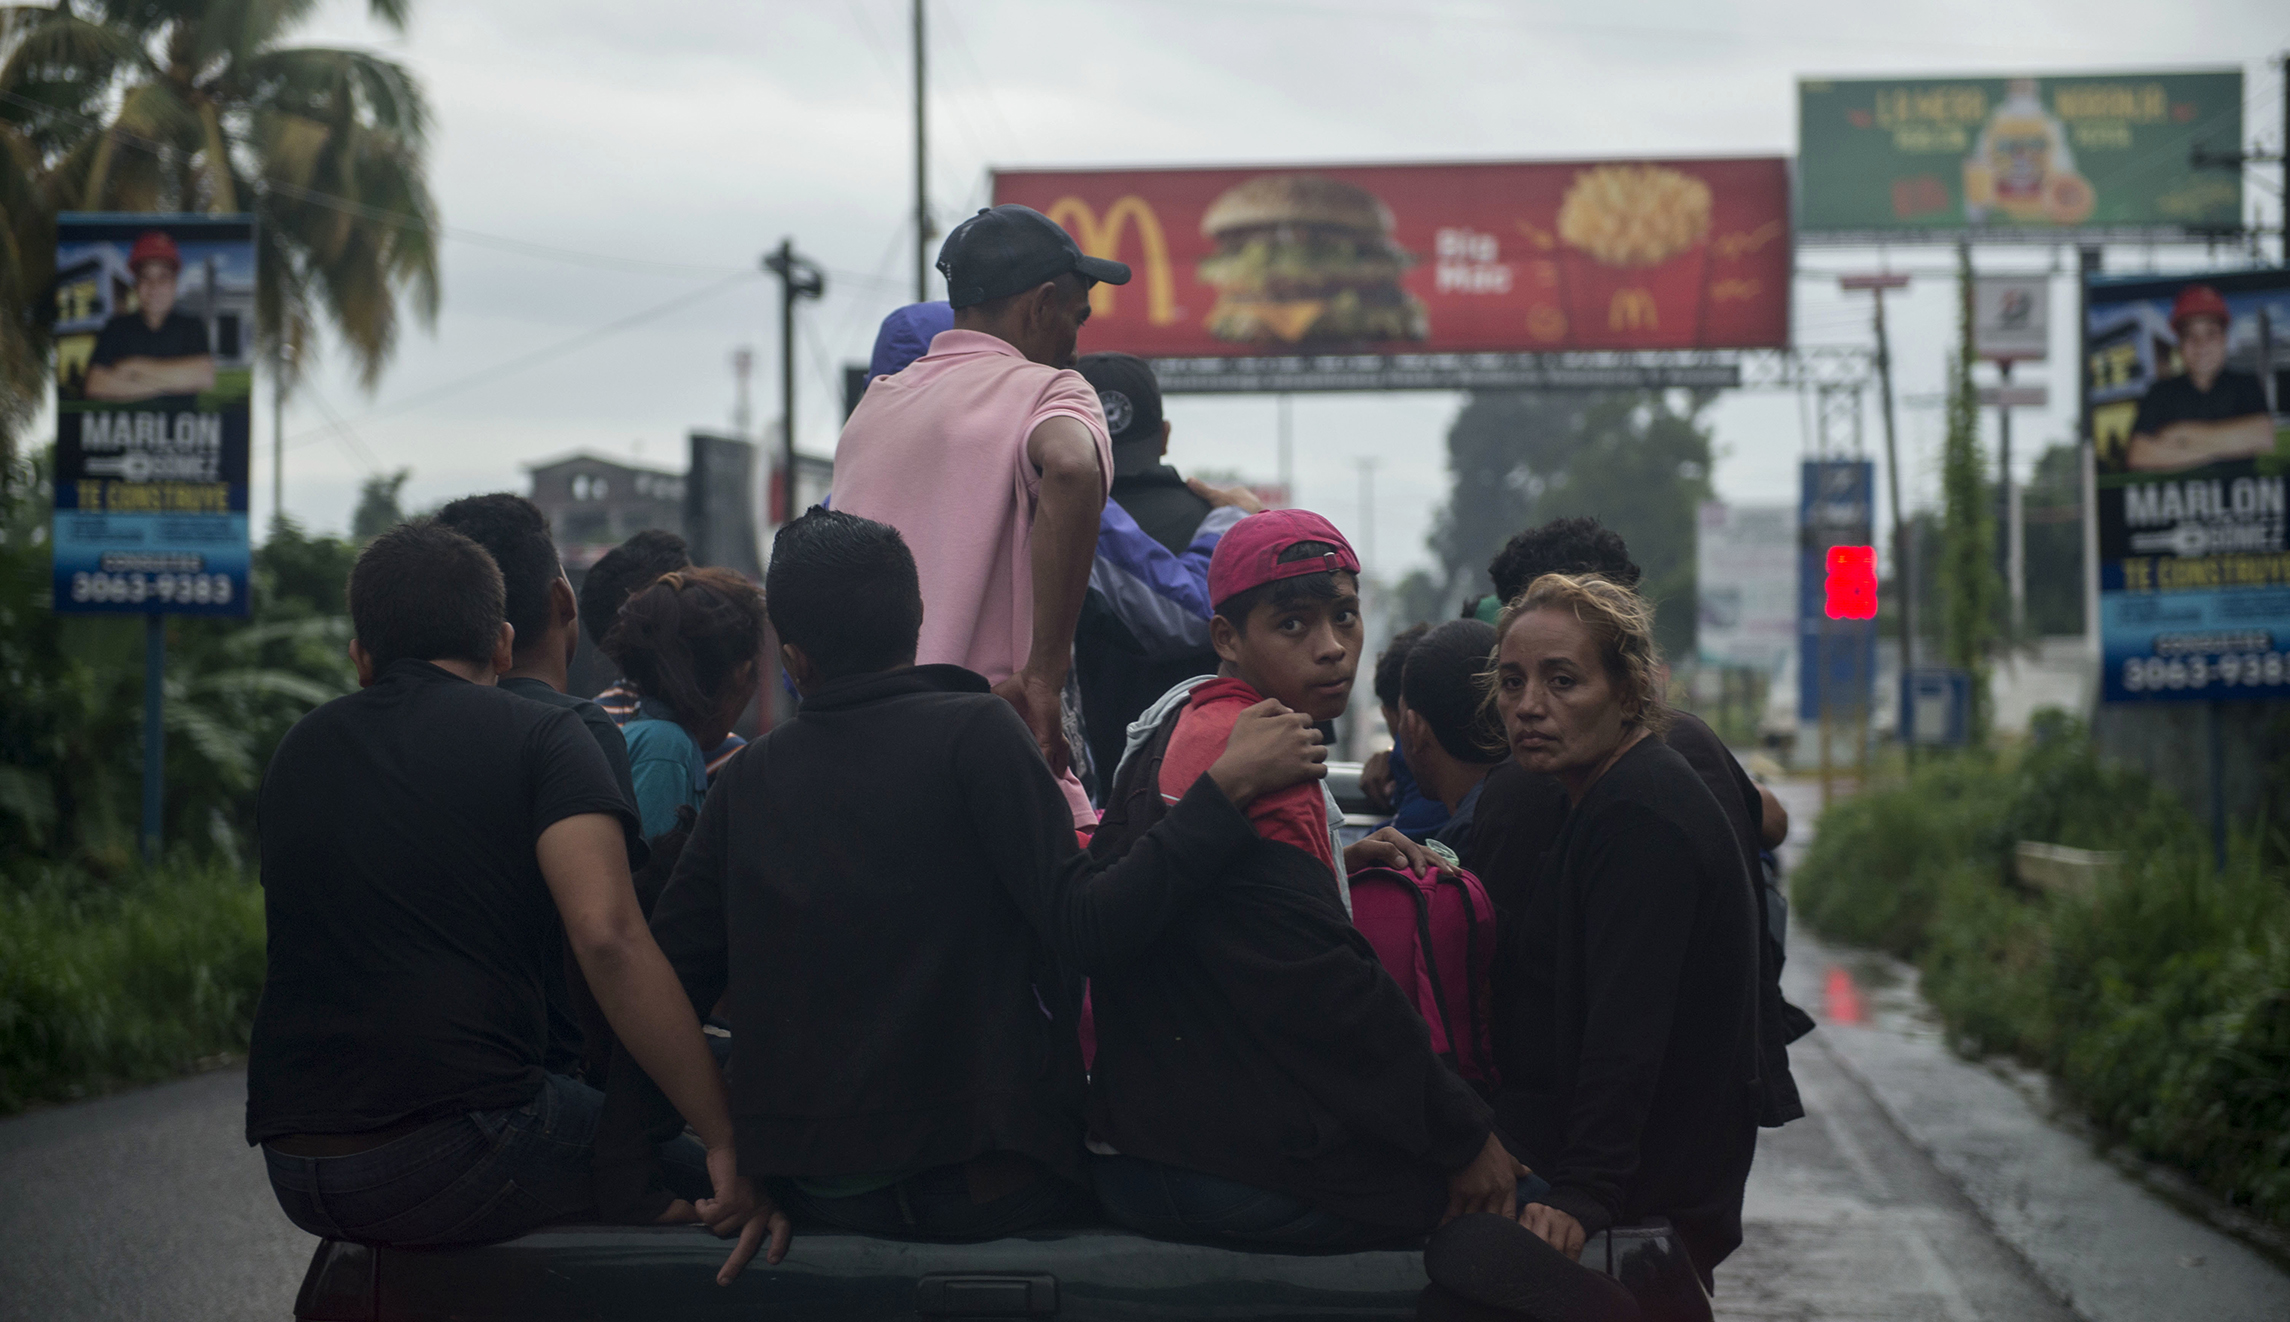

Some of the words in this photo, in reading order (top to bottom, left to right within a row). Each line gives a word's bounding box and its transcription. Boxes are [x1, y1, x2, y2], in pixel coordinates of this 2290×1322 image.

[1434, 226, 1500, 262] Big
[1434, 262, 1513, 295] Mac
[81, 411, 222, 452] MARLON
[77, 480, 102, 513] TE
[105, 481, 230, 514] CONSTRUYE
[2124, 477, 2287, 528] MARLON
[72, 571, 233, 604] 3063-9383
[2124, 558, 2151, 594] TE
